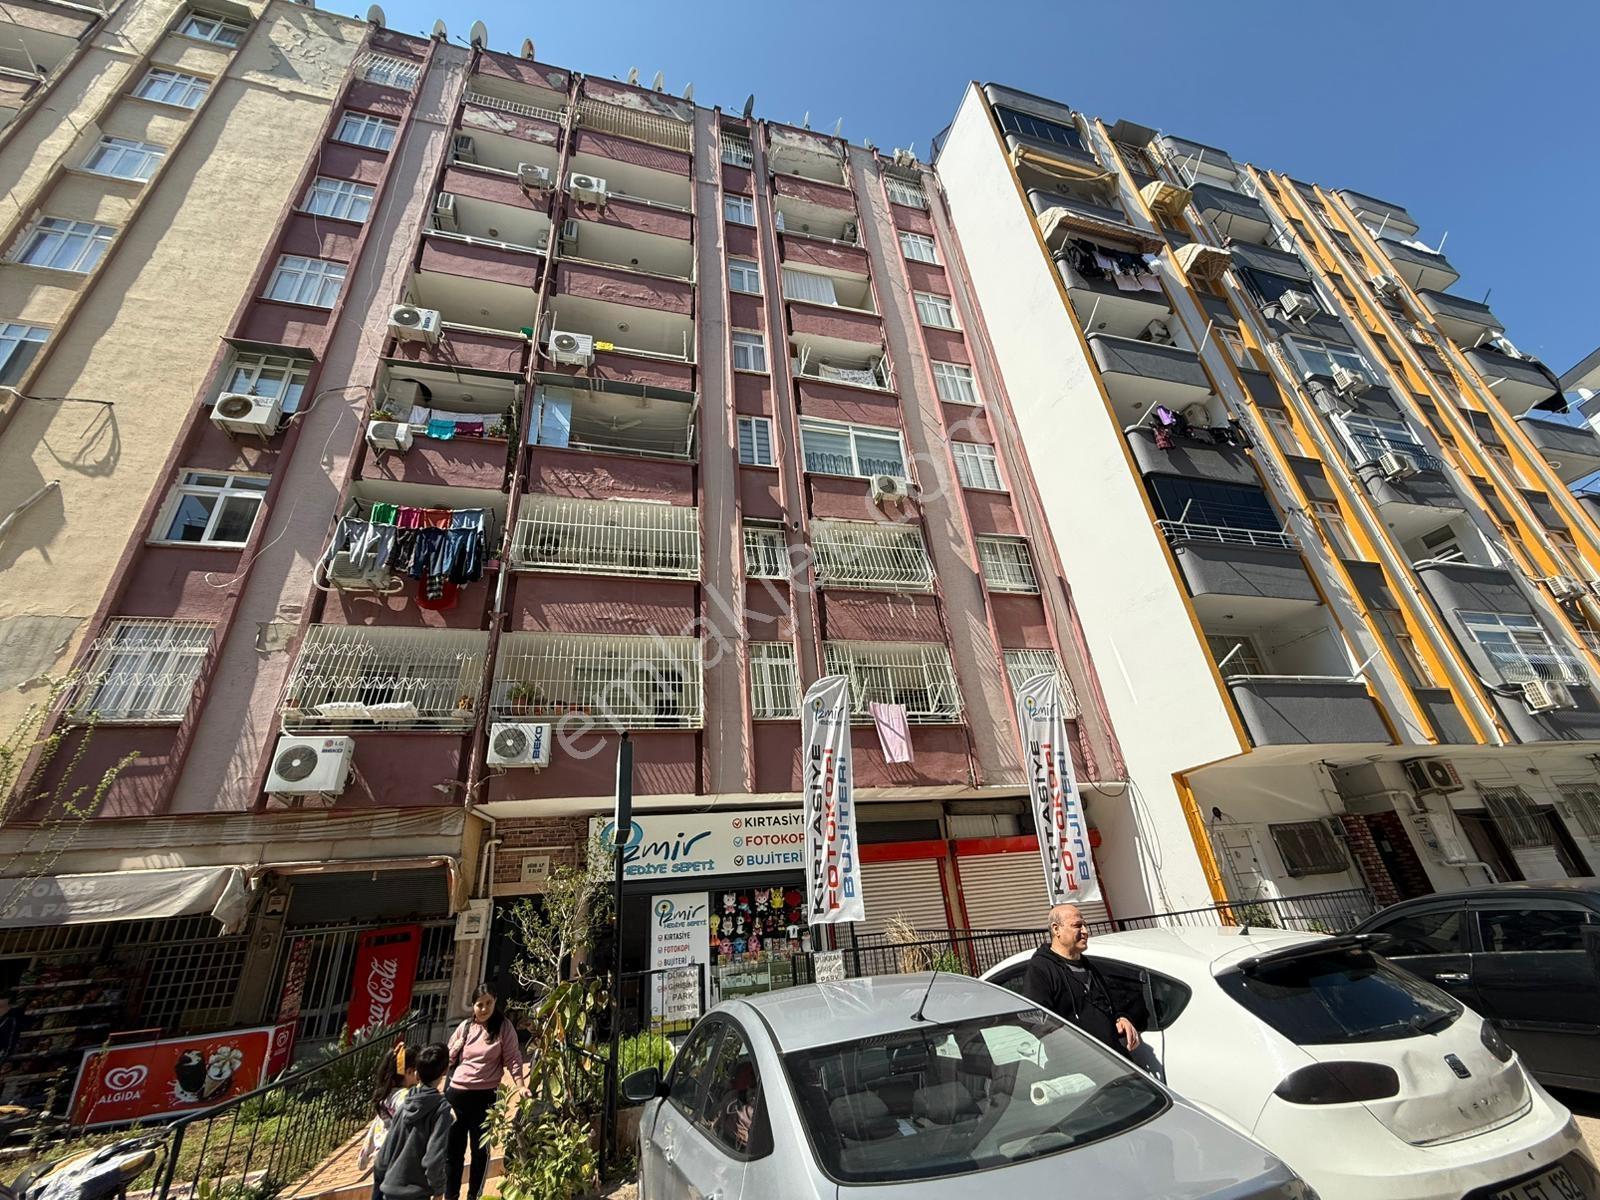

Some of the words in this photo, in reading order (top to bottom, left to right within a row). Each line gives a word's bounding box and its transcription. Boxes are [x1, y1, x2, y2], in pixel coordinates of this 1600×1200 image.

[532, 725, 543, 759] BEKO
[835, 756, 855, 899] BUJİTERİ
[1040, 743, 1078, 891] FOTOKOPİ
[1054, 751, 1090, 880] BUJİTERİ
[745, 832, 805, 847] FOTOKOP
[811, 743, 825, 915] KIRTASİYE
[823, 748, 840, 911] FOTOKOPİ
[612, 830, 712, 869] zmir
[746, 849, 803, 866] BUJİTERİ
[671, 859, 715, 873] SEPETİ
[663, 930, 691, 941] KIRTASİYE
[663, 943, 690, 954] FOTOKOPİ
[663, 955, 687, 967] BUJİTERİ
[361, 957, 397, 1042] oca-Cola
[672, 992, 694, 1001] PARK
[99, 1091, 141, 1104] ALGIDA
